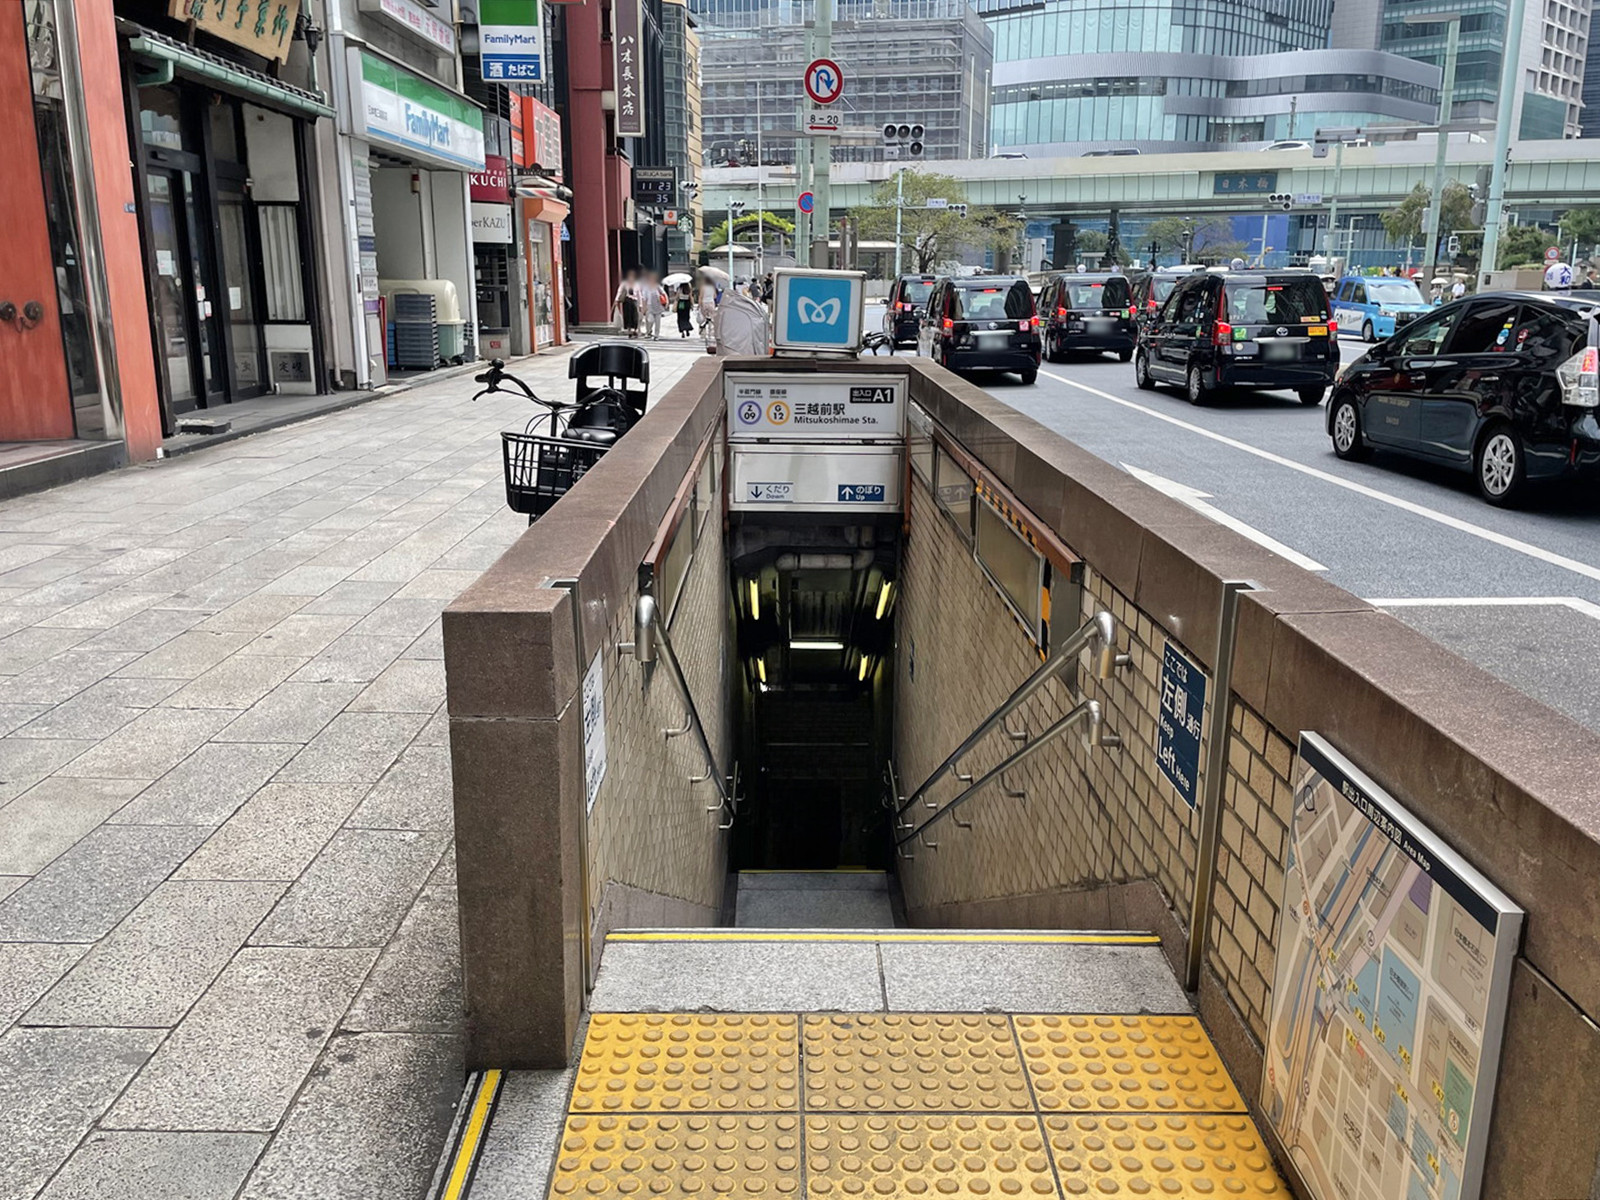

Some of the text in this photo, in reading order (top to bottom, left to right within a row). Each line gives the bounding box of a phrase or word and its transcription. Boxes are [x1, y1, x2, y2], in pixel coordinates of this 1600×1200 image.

[484, 34, 536, 46] FamilyMart
[489, 62, 536, 78] 酒 たばこ
[620, 35, 636, 116] 八木長本店
[405, 102, 450, 147] FamilyMart
[656, 194, 669, 203] 35
[1559, 266, 1572, 285] 大和
[872, 389, 891, 402] A1
[744, 412, 756, 420] 09
[773, 412, 784, 420] 12
[794, 403, 846, 416] 三越前駅
[794, 416, 878, 424] Mitsukoshimae Sta.
[766, 486, 790, 494] くだり
[856, 486, 881, 494] のぼり
[1164, 650, 1188, 683] ここでは
[1162, 674, 1200, 741] 左側通行
[1160, 713, 1174, 740] Keep
[1158, 736, 1190, 792] Left Here
[1403, 840, 1431, 872] Area Map
